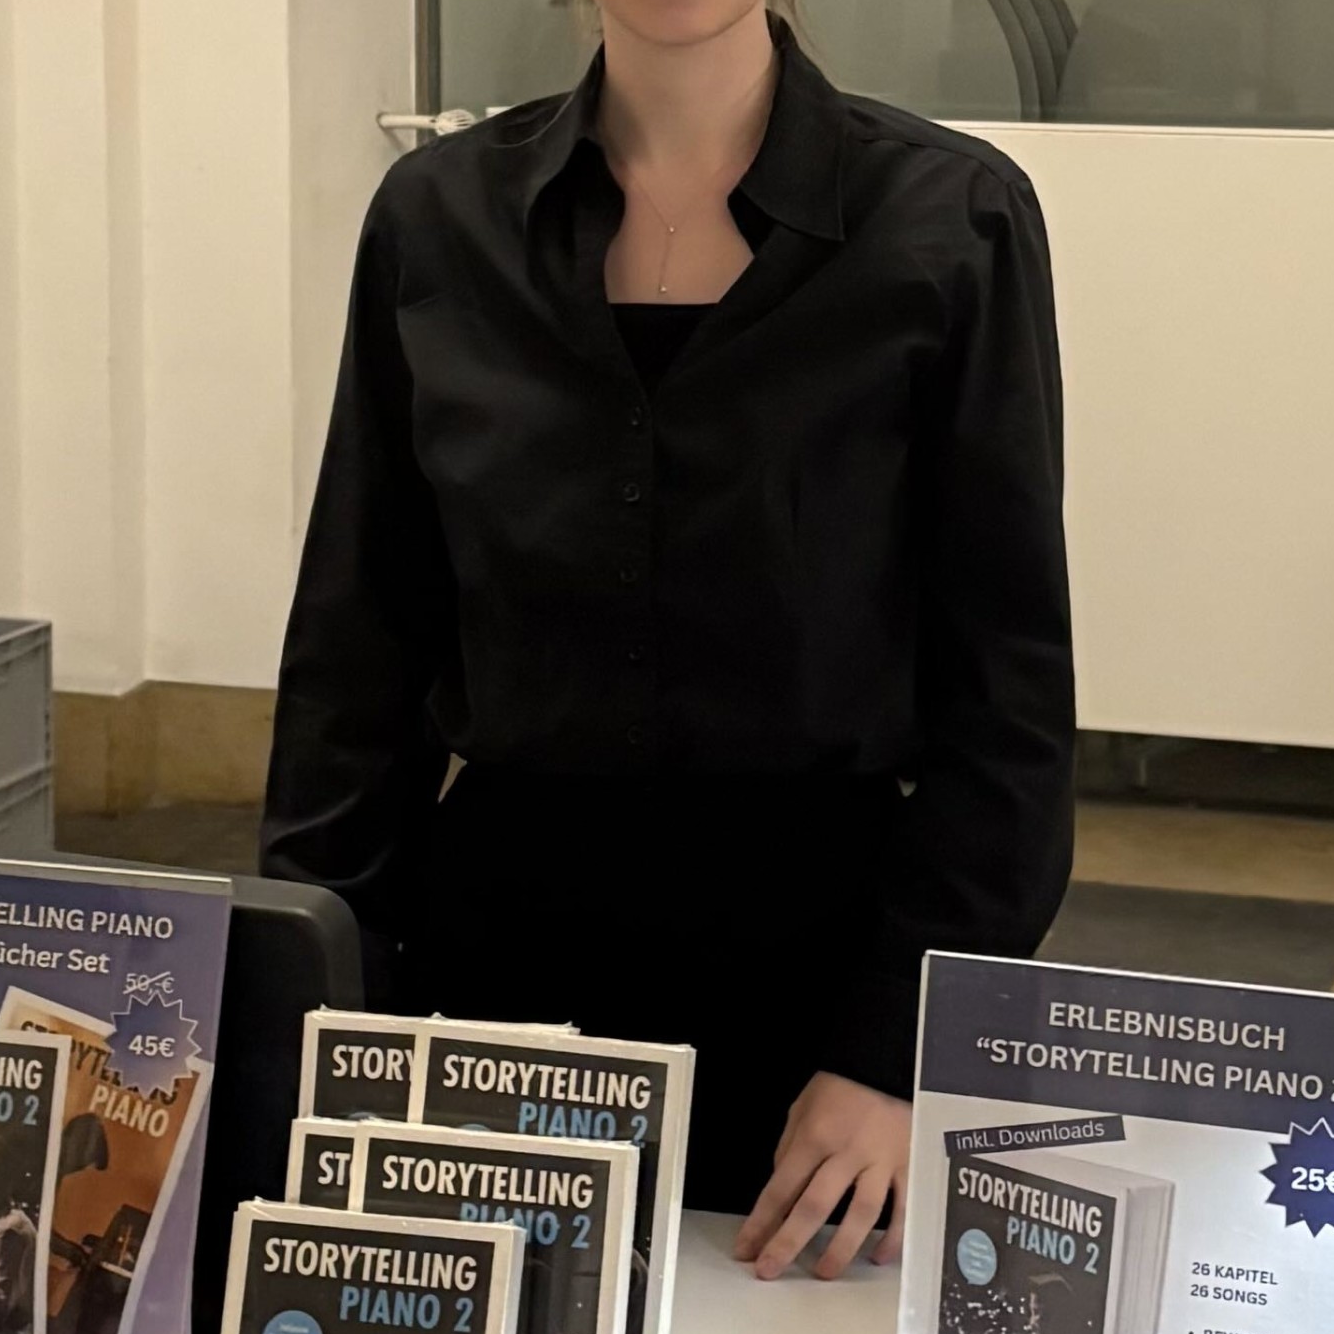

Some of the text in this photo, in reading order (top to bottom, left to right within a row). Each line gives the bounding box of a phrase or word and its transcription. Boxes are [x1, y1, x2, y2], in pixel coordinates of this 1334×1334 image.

[91, 911, 174, 940] PIANO
[67, 948, 110, 974] Set
[129, 1034, 176, 1058] 45€
[1048, 1001, 1285, 1052] ERLEBNISBUCH
[443, 1054, 651, 1110] STORYTELLING
[1224, 1069, 1323, 1101] PIANO
[24, 1097, 39, 1126] 2
[89, 1084, 169, 1138] PIANO
[518, 1101, 648, 1147] PIANO 2
[956, 1120, 1105, 1150] inkl. Downloads
[382, 1154, 594, 1209] STORYTELLING
[958, 1167, 1102, 1238] STORYTELLING
[571, 1215, 590, 1249] 2
[1006, 1215, 1076, 1265] PIANO
[1084, 1242, 1100, 1275] 2
[264, 1237, 477, 1291] STORYTELLING
[1190, 1262, 1278, 1286] 26 KAPITEL
[339, 1285, 474, 1333] PIANO 2
[1190, 1284, 1268, 1307] 26 SONGS
